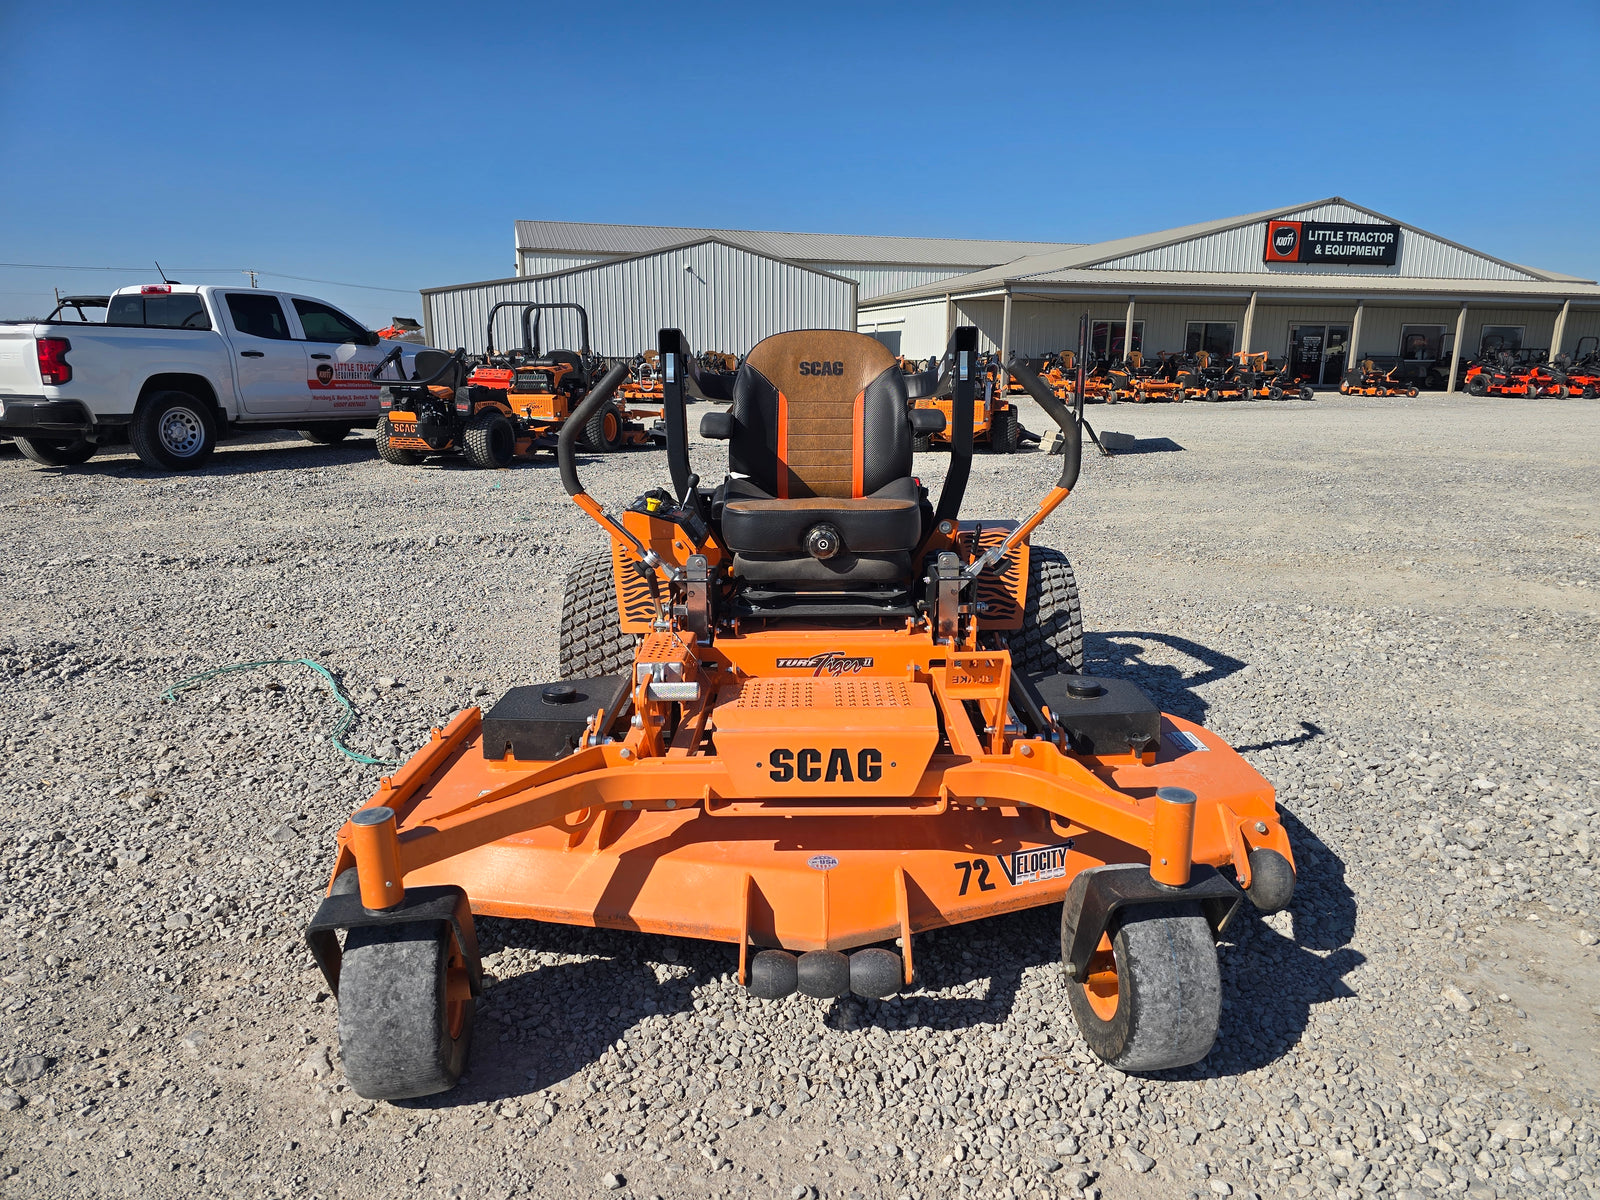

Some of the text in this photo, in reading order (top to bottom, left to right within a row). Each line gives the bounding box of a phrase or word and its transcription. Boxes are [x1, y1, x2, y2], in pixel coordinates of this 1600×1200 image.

[1275, 236, 1294, 247] KIOTI
[1308, 230, 1394, 243] LITTLE TRACTOR
[1314, 244, 1385, 257] & EQUIPMENT
[334, 363, 355, 372] LITTLE
[799, 361, 844, 376] SCAG
[394, 423, 416, 433] SCAG
[778, 652, 872, 677] TURF Tiger II
[769, 748, 882, 782] SCAG
[954, 841, 1071, 896] 72 VELOCITY
[1016, 867, 1067, 886] PLUS
